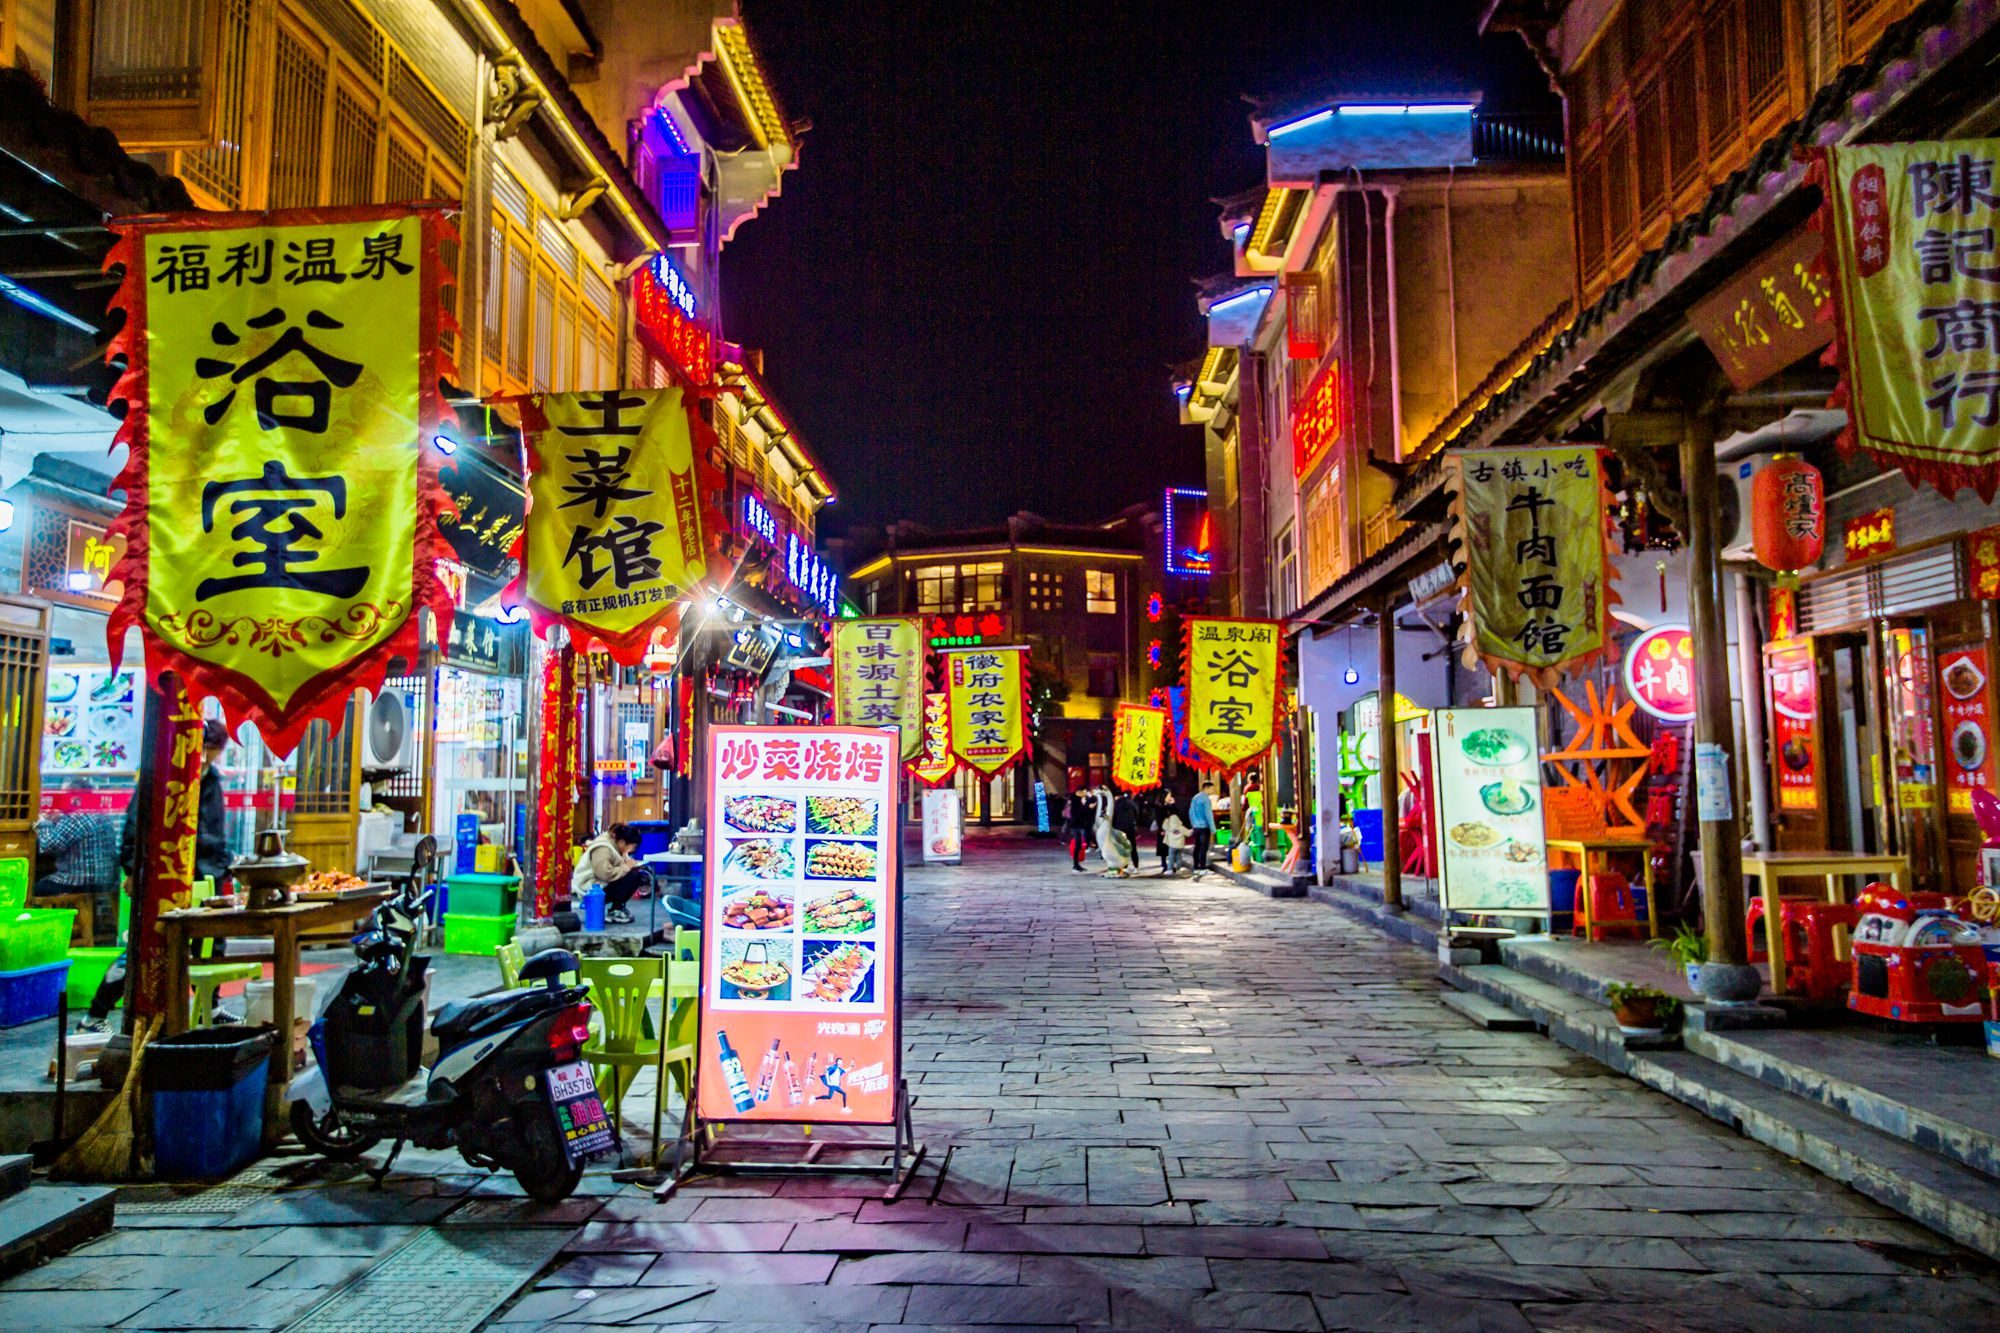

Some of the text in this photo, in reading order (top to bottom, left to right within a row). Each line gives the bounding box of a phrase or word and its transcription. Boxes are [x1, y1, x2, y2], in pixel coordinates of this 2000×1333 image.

[151, 231, 415, 294] 福利温泉
[1857, 173, 1883, 266] 烟酒饮料
[1907, 154, 2000, 430] 陳記商行
[195, 307, 371, 601] 浴室
[556, 390, 665, 591] 土菜馆
[1470, 454, 1591, 483] 古镇小吃
[674, 478, 696, 558] 十二年老店
[560, 583, 681, 616] 备有正规机打发票
[1506, 486, 1571, 655] 牛肉面馆
[856, 623, 903, 722] 百味源土菜
[1198, 626, 1272, 644] 温泉阁
[965, 654, 1009, 745] 徽府农家菜
[1206, 648, 1260, 739] 浴室
[721, 738, 884, 783] 炒菜烧烤
